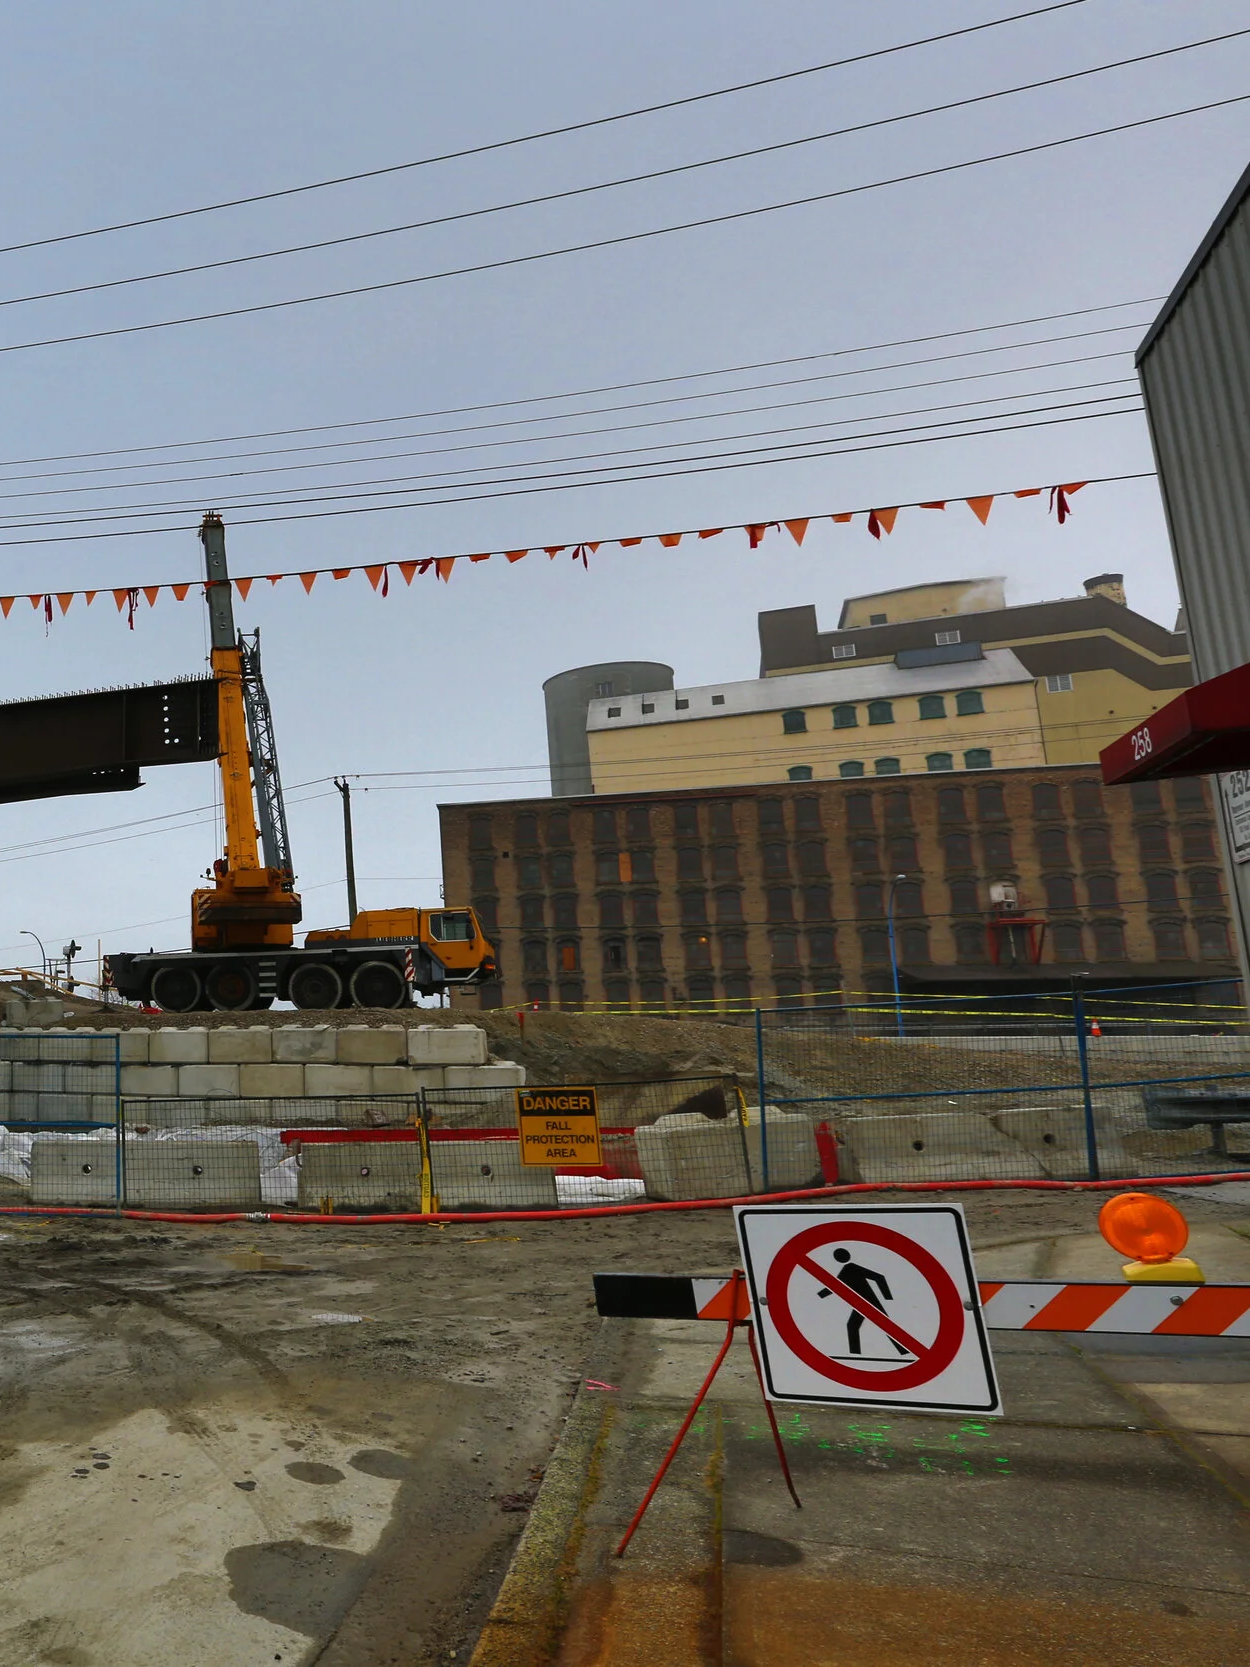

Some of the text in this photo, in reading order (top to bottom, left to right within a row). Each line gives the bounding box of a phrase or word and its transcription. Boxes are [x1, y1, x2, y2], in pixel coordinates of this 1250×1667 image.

[1132, 728, 1152, 760] 258
[523, 1096, 590, 1110] DANGER
[546, 1121, 571, 1130] FALL
[525, 1135, 595, 1144] PROTECTION
[546, 1148, 577, 1157] AREA
